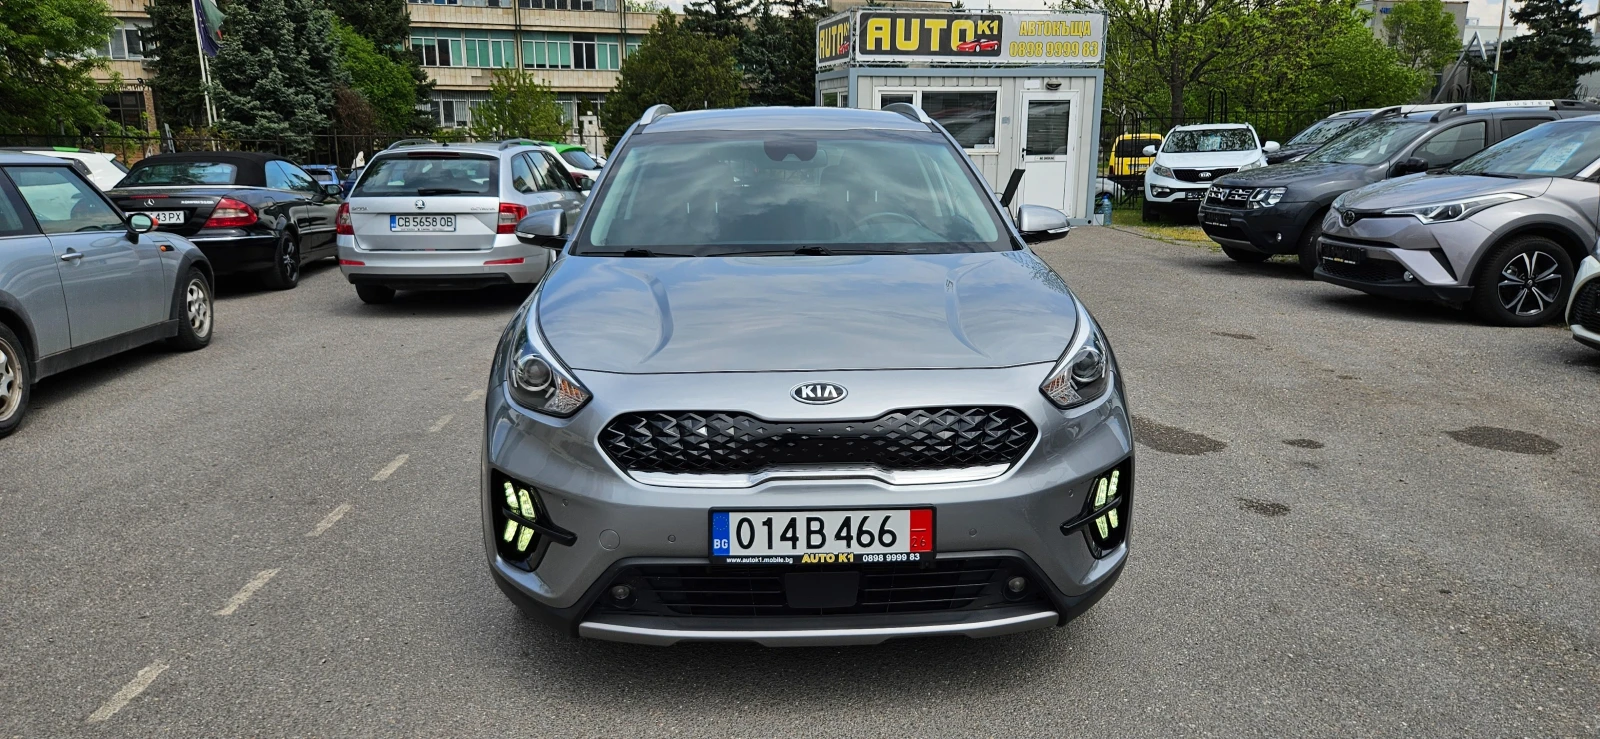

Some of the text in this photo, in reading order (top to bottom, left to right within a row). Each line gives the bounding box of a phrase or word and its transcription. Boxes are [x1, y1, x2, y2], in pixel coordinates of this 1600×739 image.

[866, 18, 998, 52] AUTO K1
[1019, 20, 1091, 38] АВТОКЪЩА
[820, 24, 844, 59] AUTO
[1009, 41, 1099, 58] 0898 9999 83
[397, 216, 410, 228] CB
[412, 216, 438, 227] 5658
[801, 384, 838, 398] KIA
[714, 538, 728, 549] BG
[801, 552, 854, 563] AUTO K1
